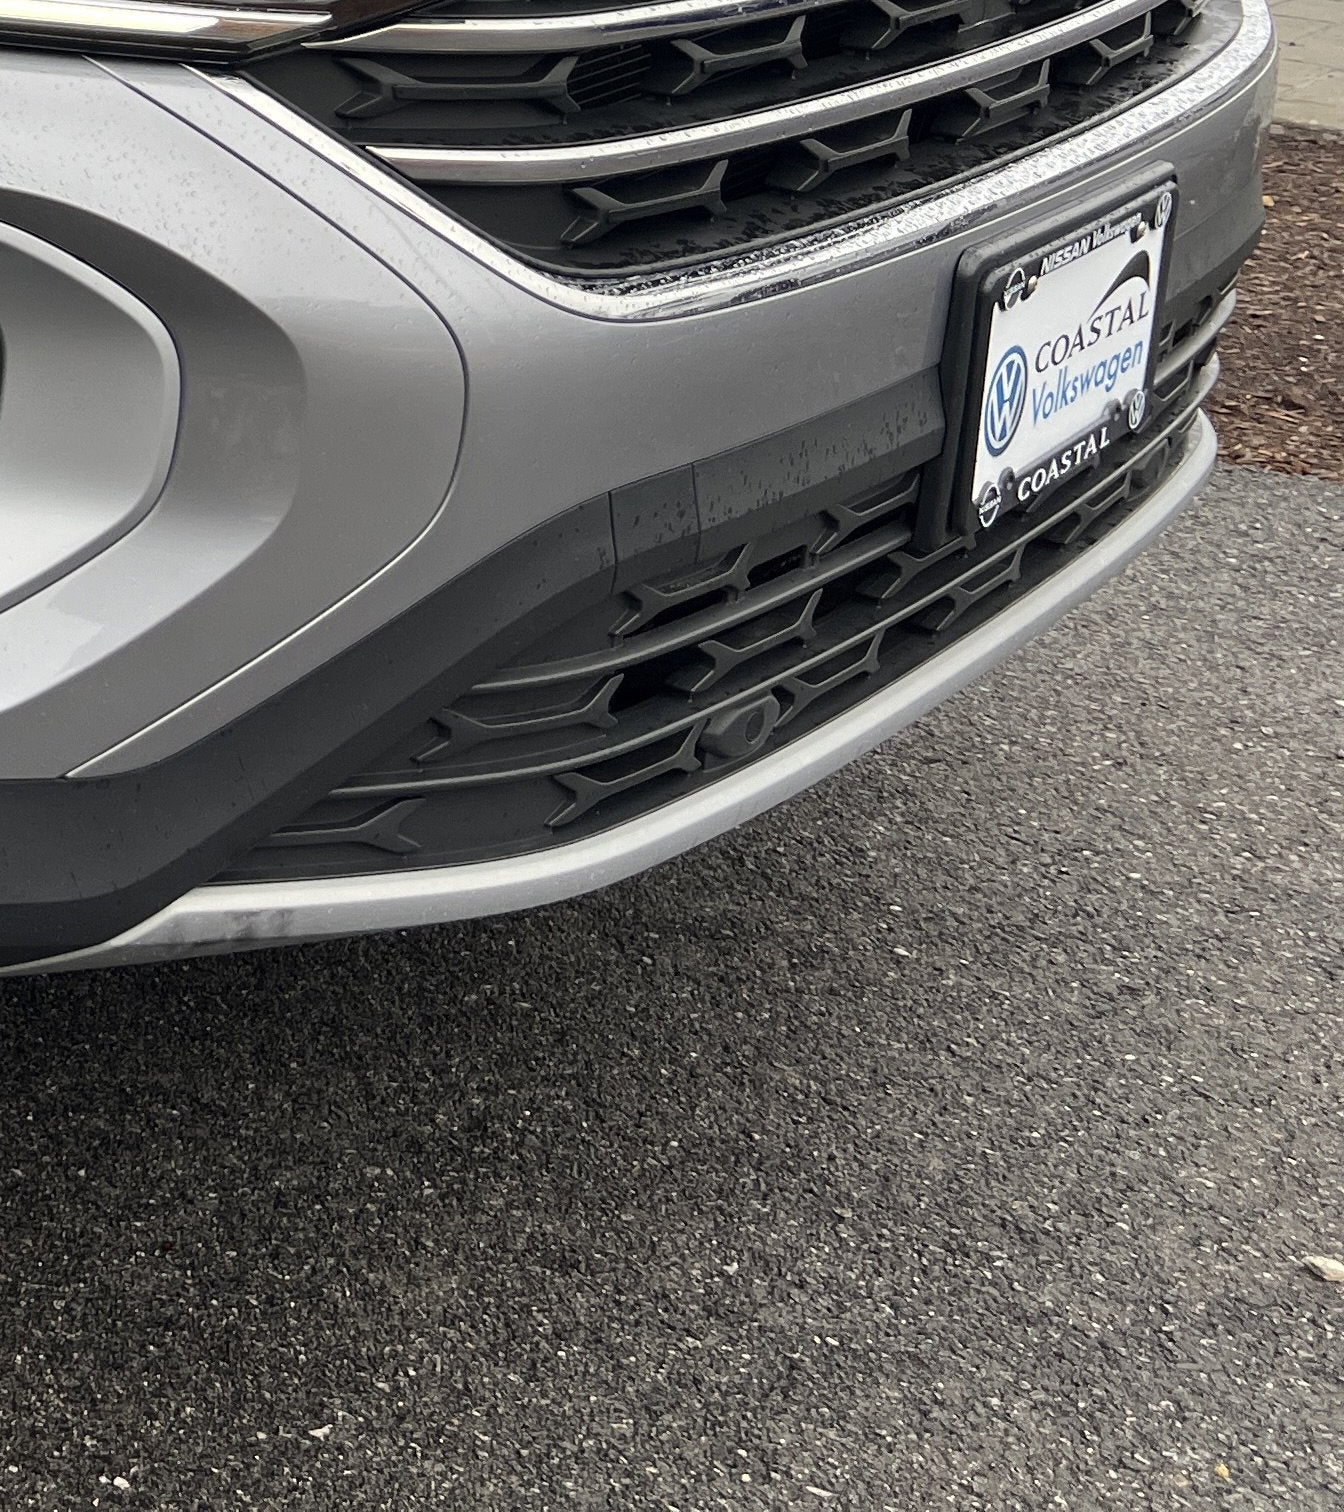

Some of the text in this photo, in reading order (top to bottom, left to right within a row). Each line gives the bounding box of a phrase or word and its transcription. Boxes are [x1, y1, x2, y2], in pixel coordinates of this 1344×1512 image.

[1040, 236, 1092, 277] NISSAN
[1034, 290, 1150, 373] COASTAL
[1031, 340, 1144, 427] Volkswagen
[1017, 426, 1111, 502] COASTAL
